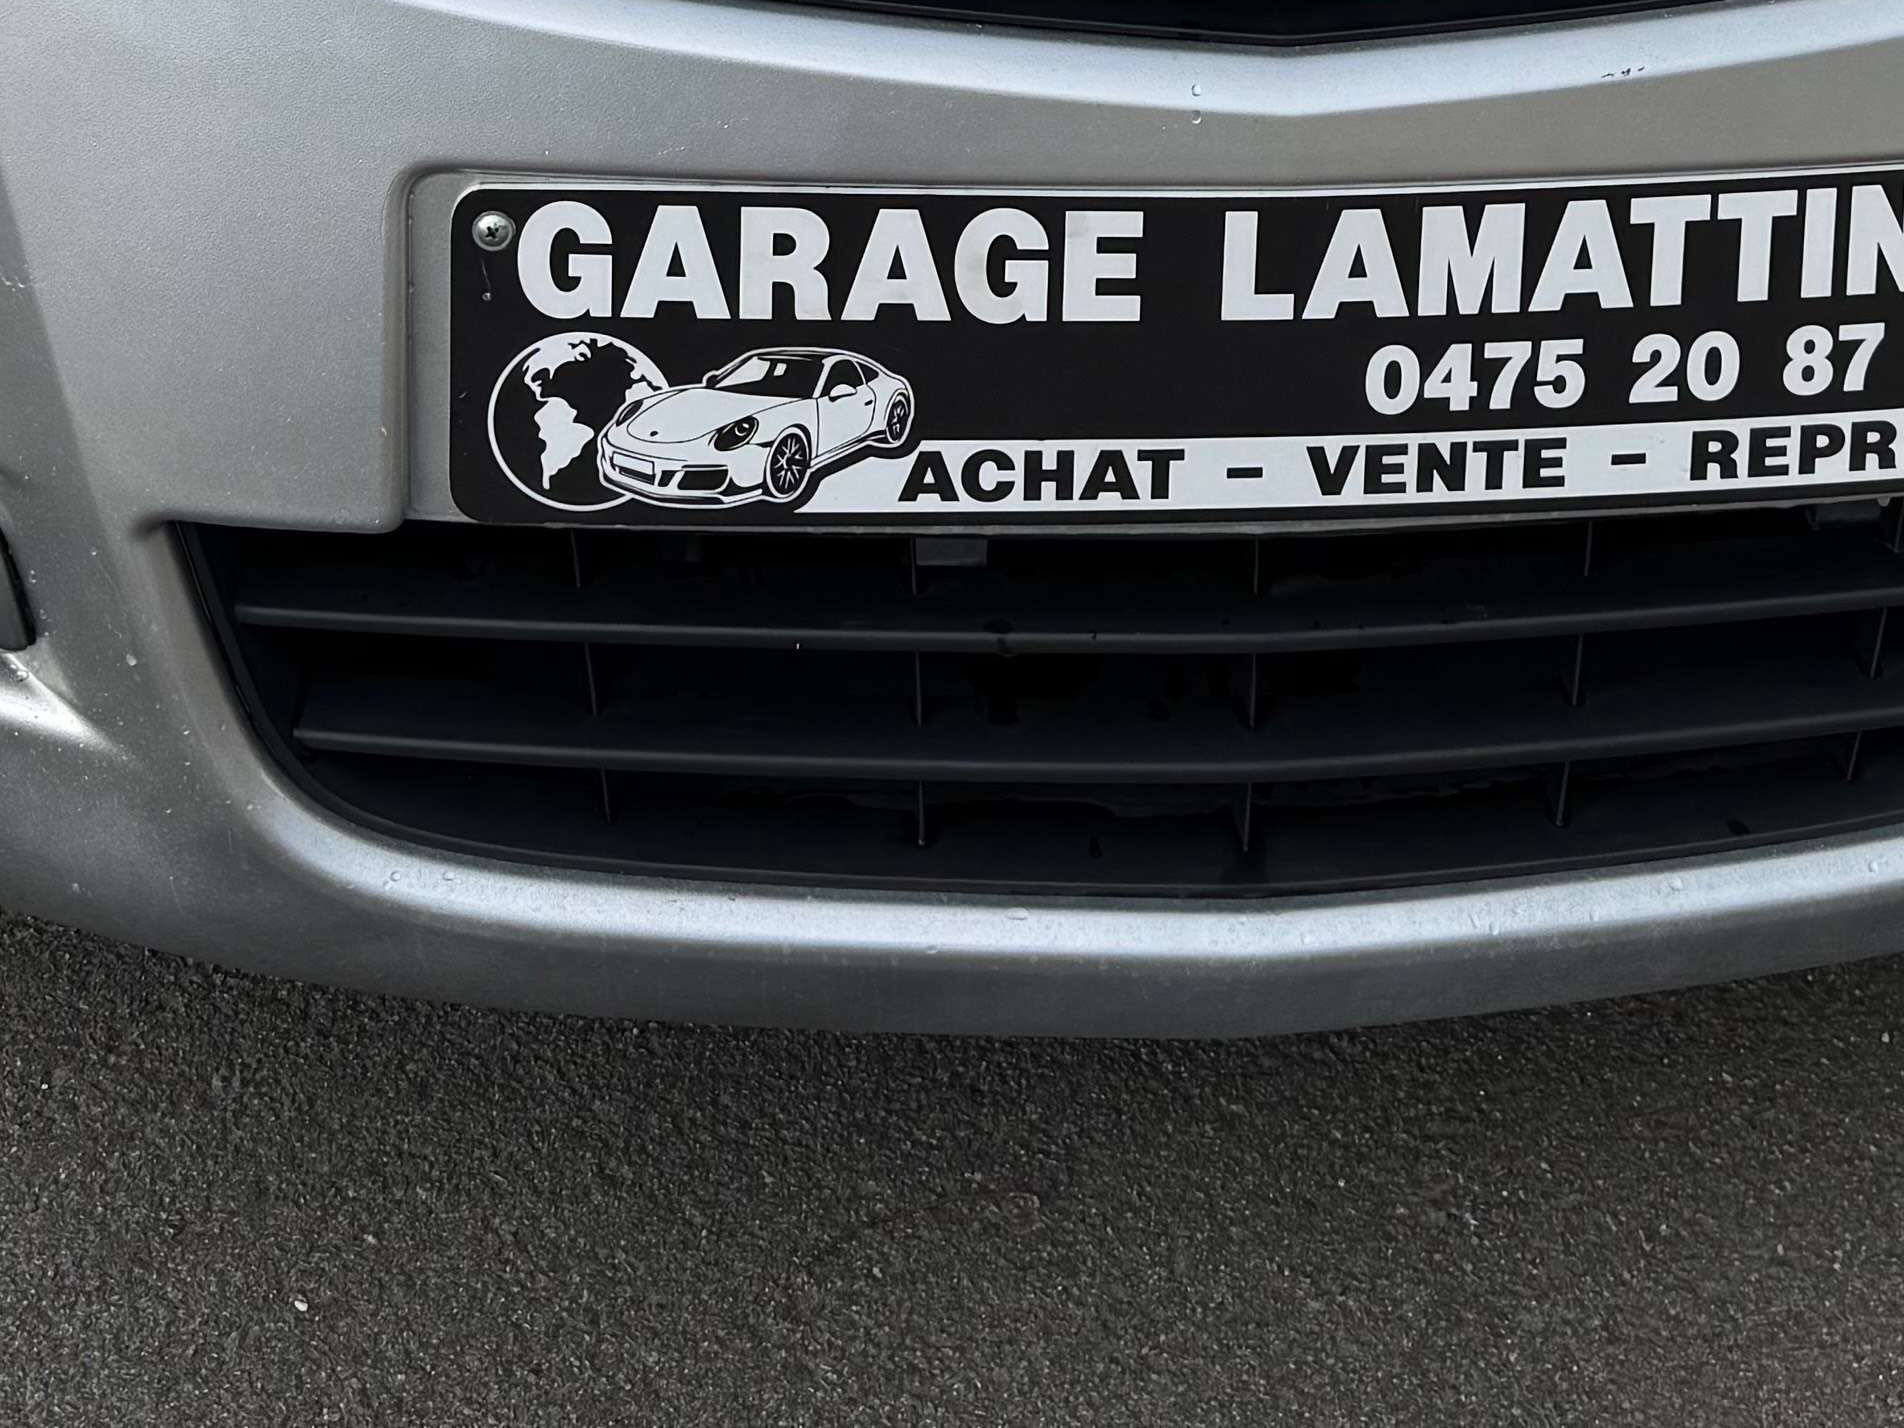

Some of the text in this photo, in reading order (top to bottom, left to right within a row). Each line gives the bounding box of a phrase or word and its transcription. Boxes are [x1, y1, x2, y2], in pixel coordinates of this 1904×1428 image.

[516, 200, 1142, 324] GARAGE
[1365, 338, 1586, 416] 0475
[1628, 330, 1740, 405] 20
[1782, 322, 1885, 397] 87
[899, 448, 1186, 505] ACHAT
[1308, 437, 1569, 498] VENTE
